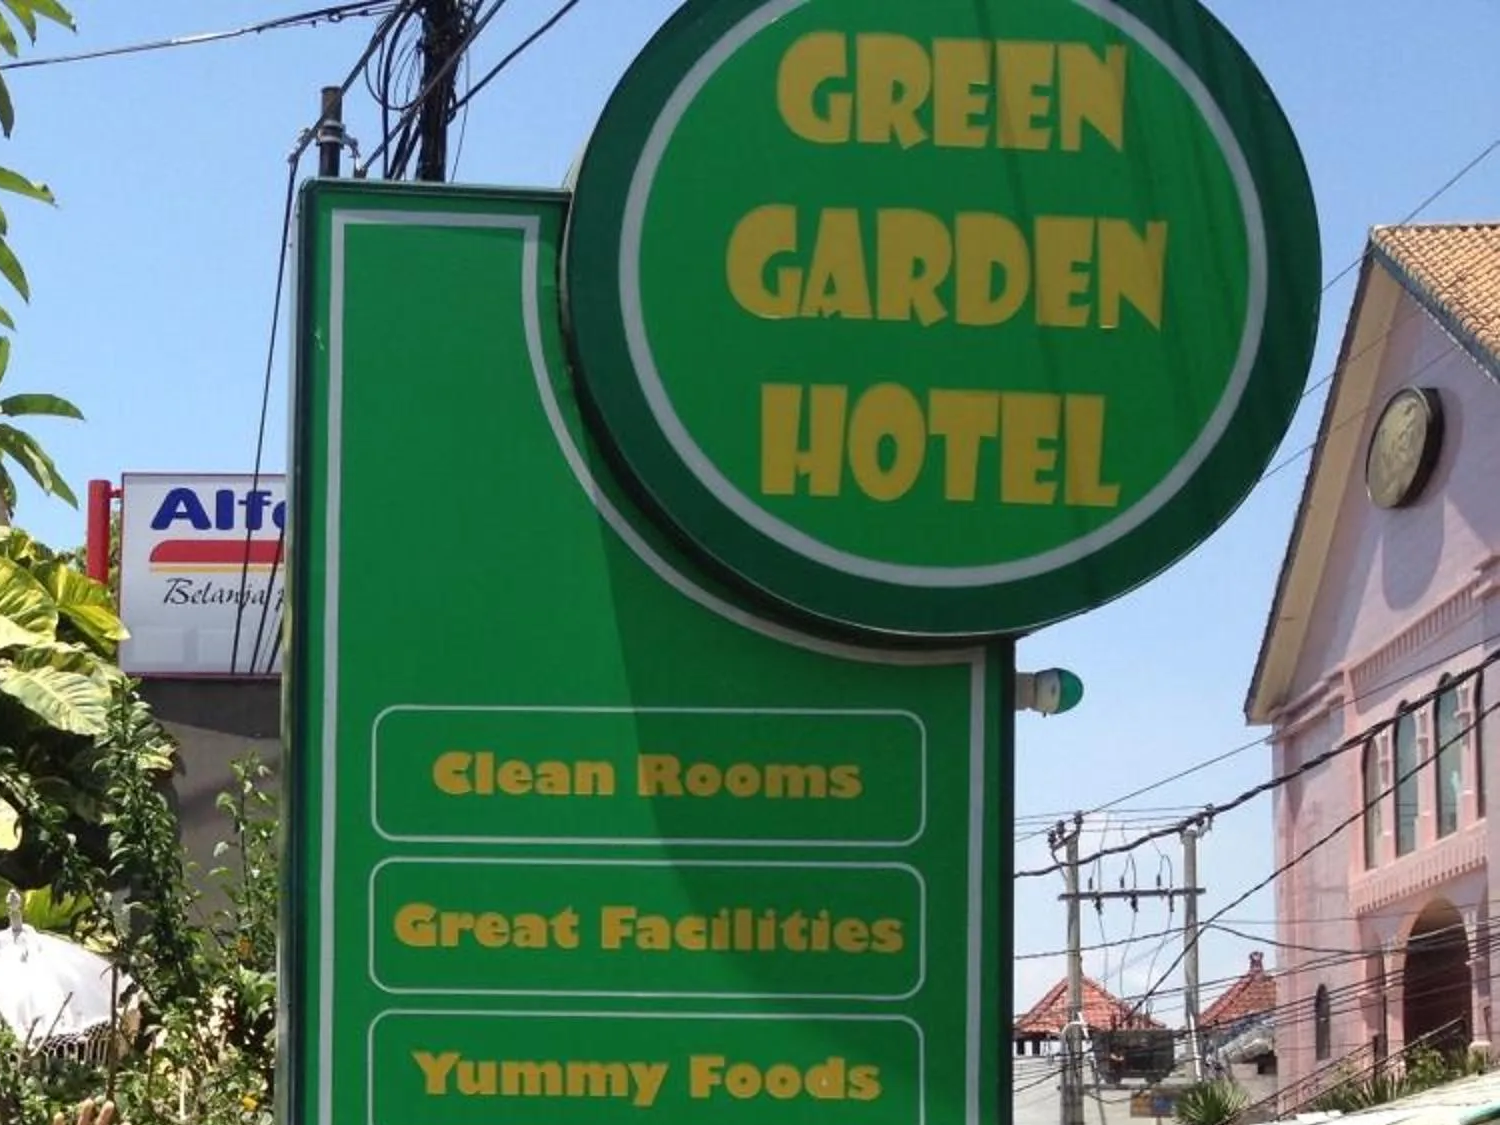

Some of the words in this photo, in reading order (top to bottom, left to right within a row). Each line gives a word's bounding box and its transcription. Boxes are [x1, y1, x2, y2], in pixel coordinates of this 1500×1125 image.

[778, 31, 1128, 152] GREEN
[726, 204, 1167, 331] GARDEN
[761, 382, 1120, 507] HOTEL
[433, 751, 615, 796] Clean
[637, 754, 863, 798] Rooms
[393, 902, 579, 948] Great
[601, 906, 904, 953] Facilities
[412, 1051, 668, 1106] Yummy
[690, 1056, 882, 1100] Foods
